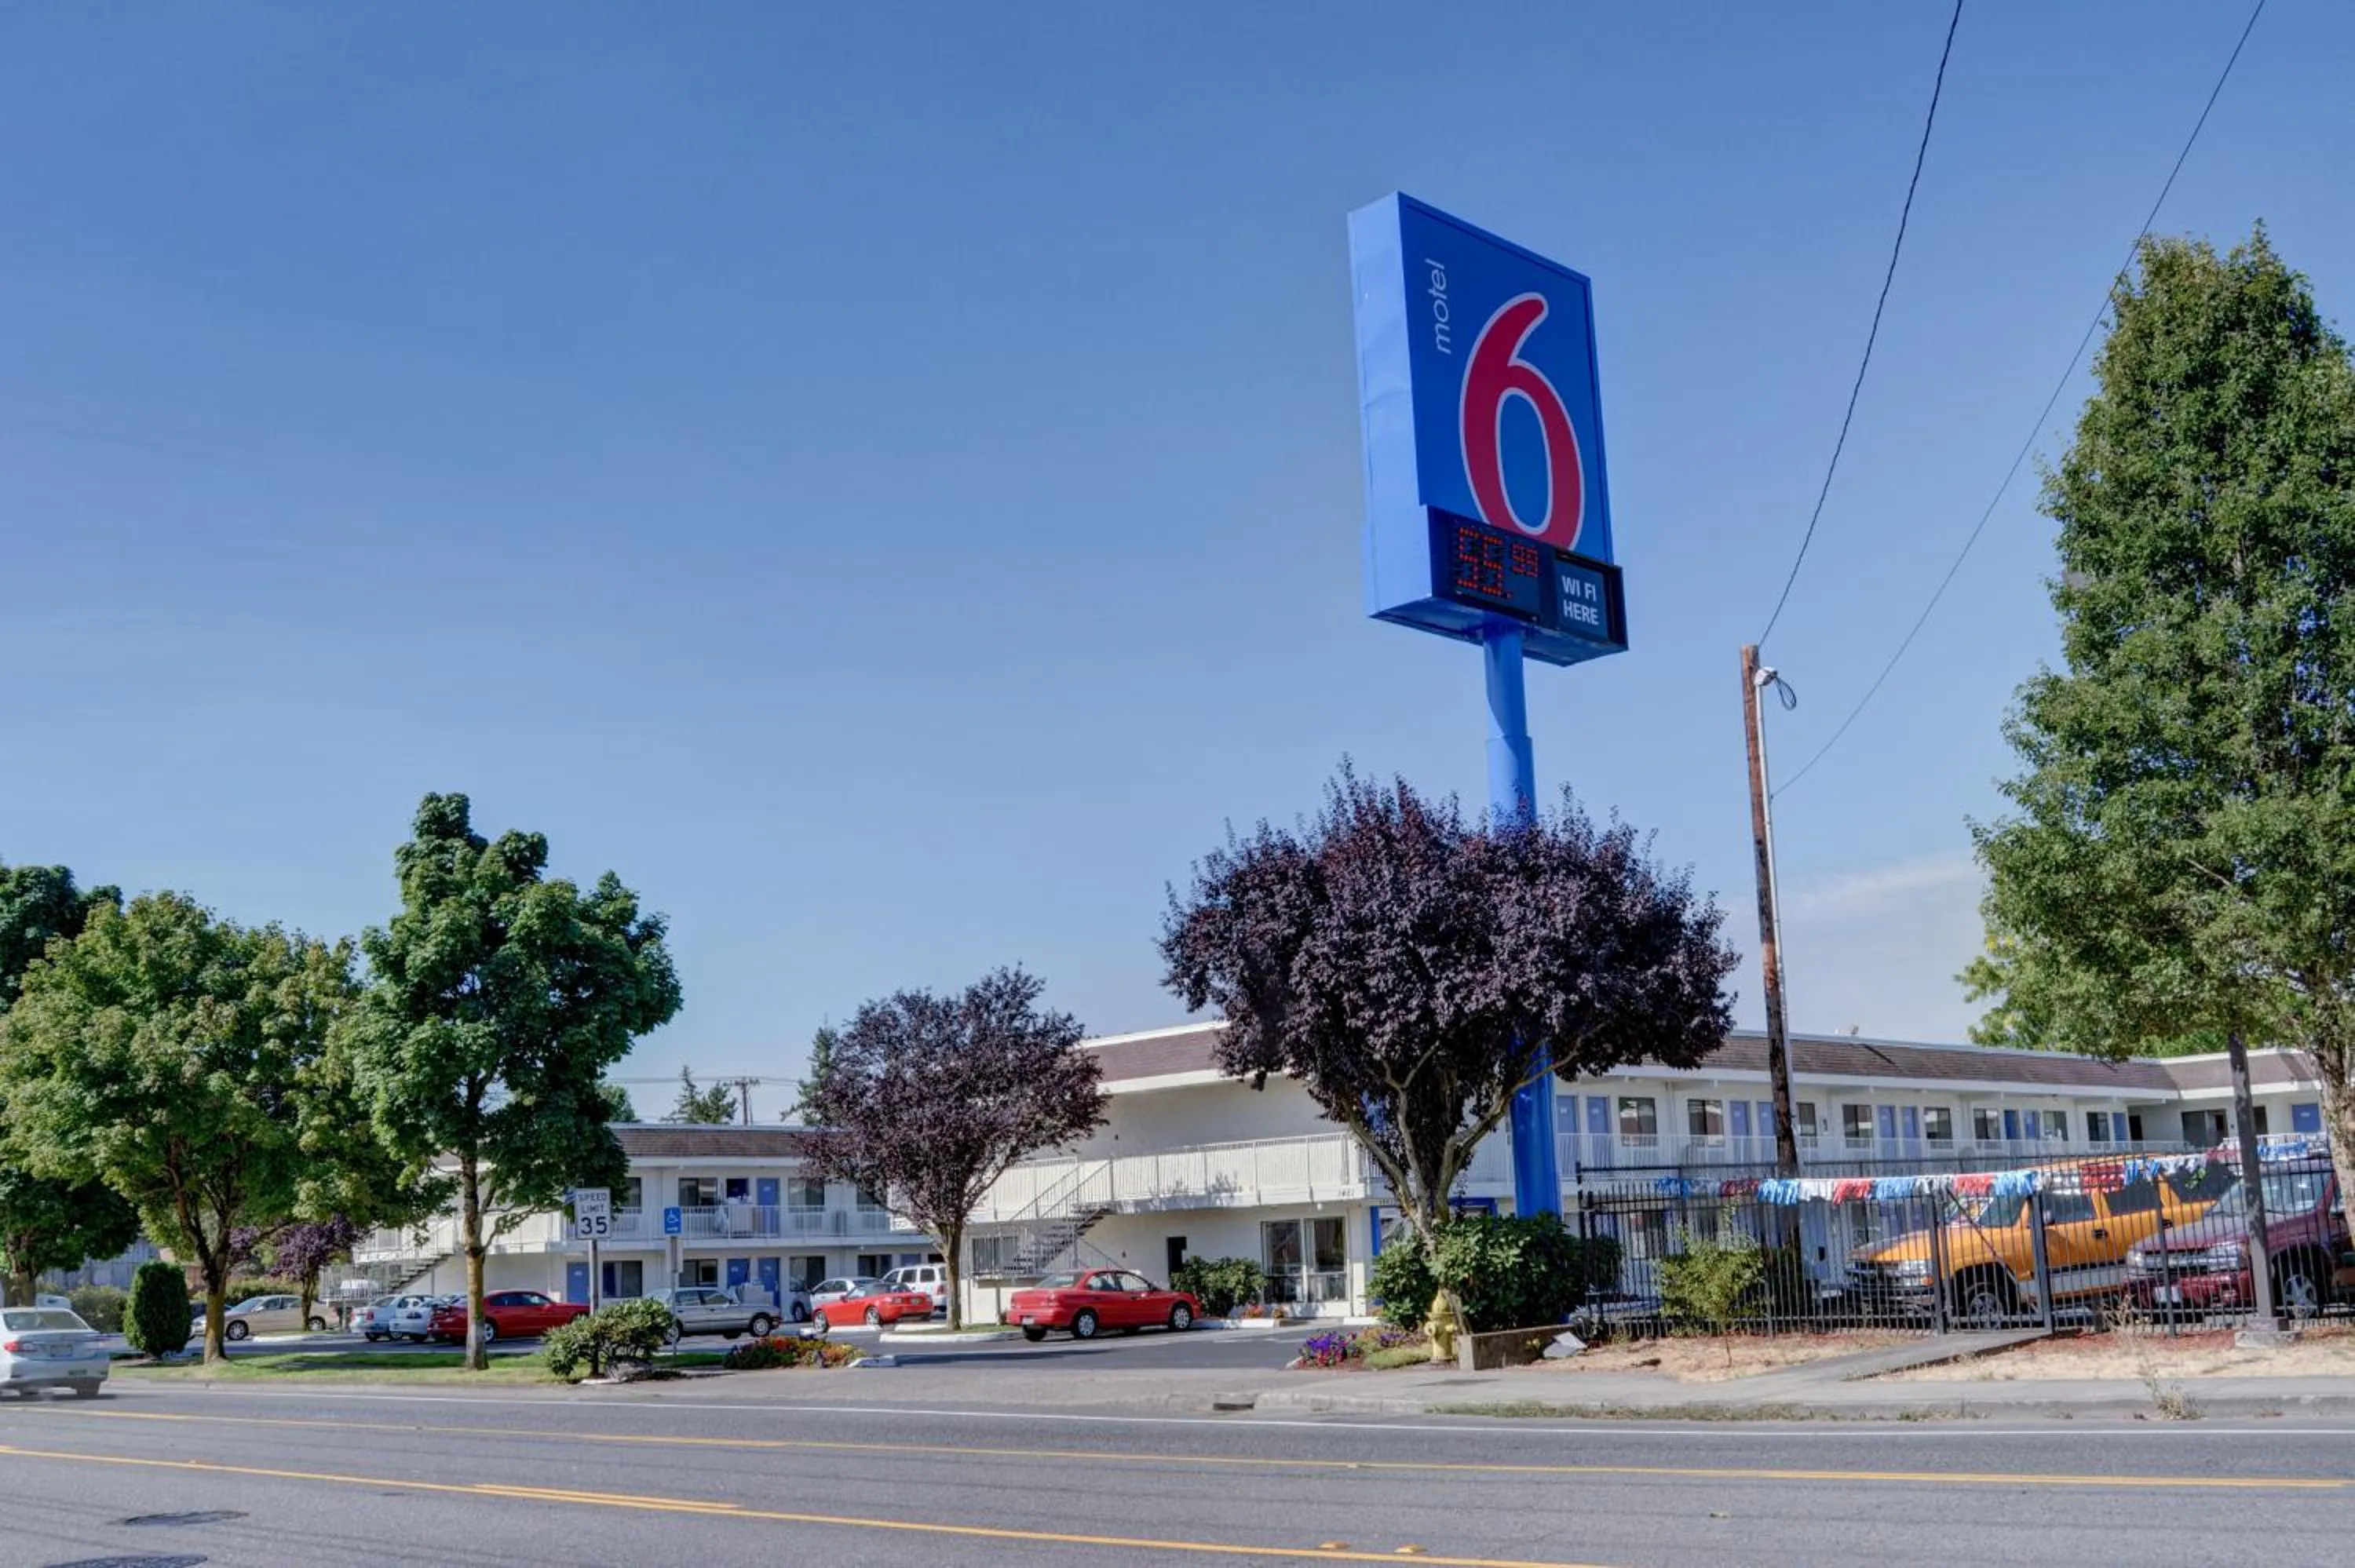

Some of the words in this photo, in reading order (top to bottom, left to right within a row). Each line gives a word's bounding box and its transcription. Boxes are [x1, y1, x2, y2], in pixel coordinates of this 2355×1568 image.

[1425, 257, 1451, 355] motel
[1459, 291, 1585, 552] 6
[1561, 575, 1581, 597] WI
[1584, 583, 1597, 603] FI
[1563, 600, 1599, 626] HERE
[578, 1192, 608, 1202] SPEED
[582, 1204, 605, 1214] LIMIT
[581, 1216, 608, 1235] 35
